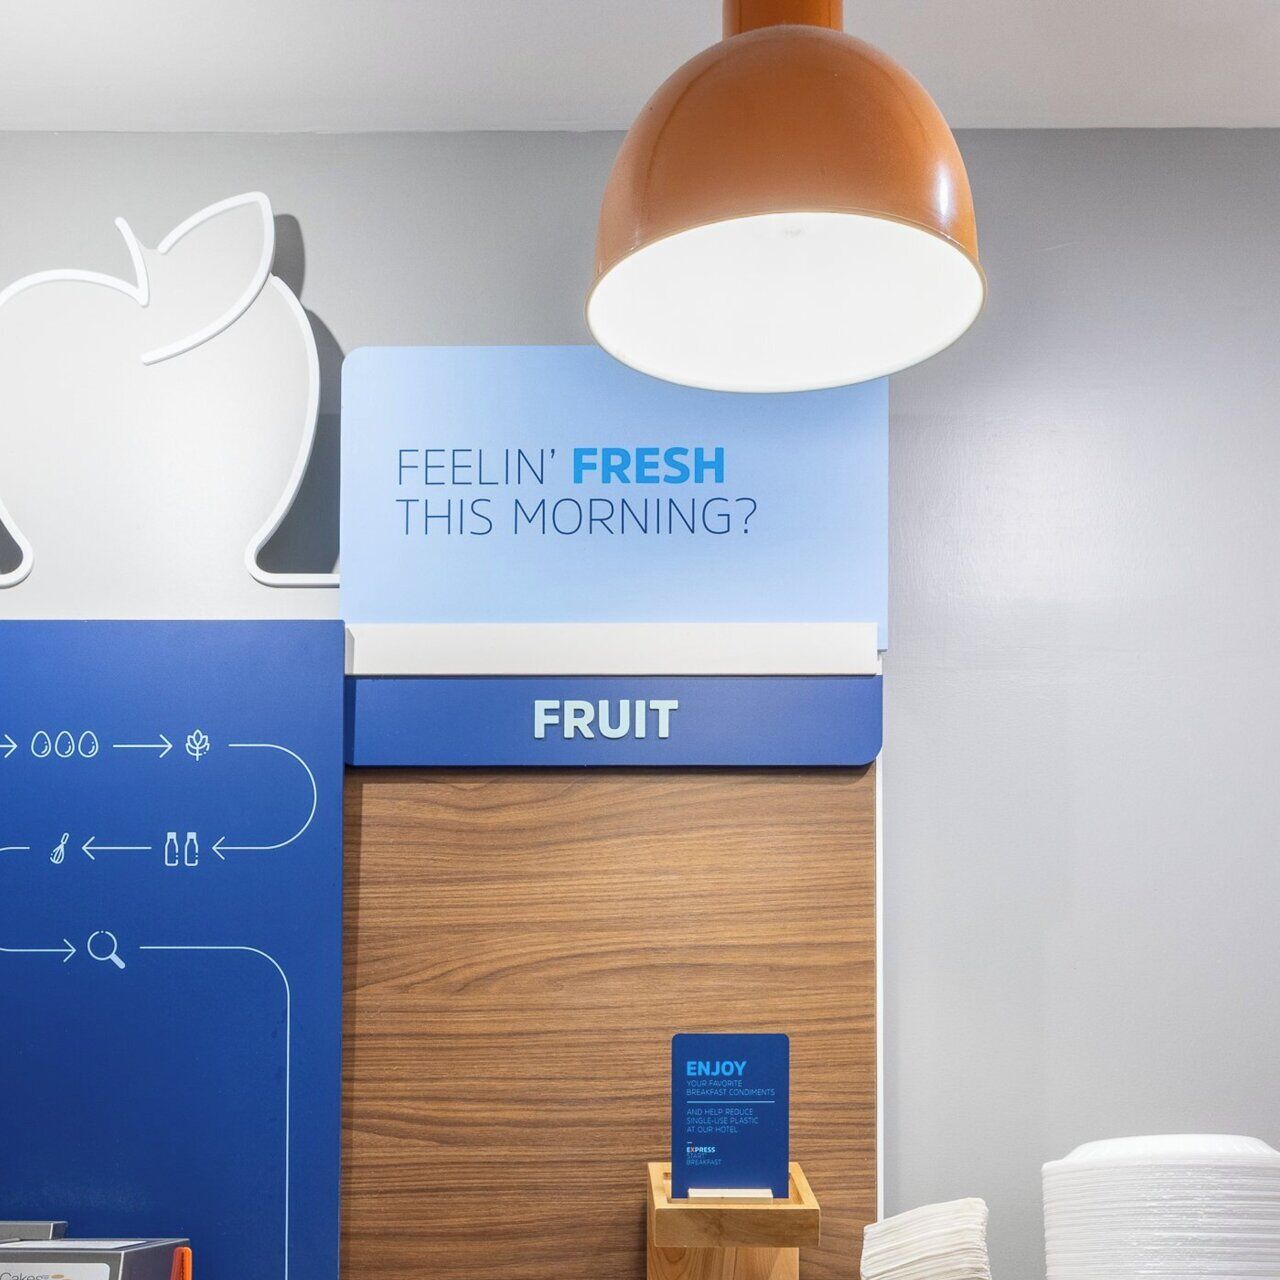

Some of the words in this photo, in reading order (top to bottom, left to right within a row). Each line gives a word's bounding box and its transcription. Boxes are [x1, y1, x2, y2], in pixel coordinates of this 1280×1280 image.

[574, 447, 724, 484] FRESH
[396, 499, 492, 535] THIS
[515, 497, 756, 535] MORNING?
[533, 700, 678, 741] FRUIT
[687, 1061, 747, 1076] ENJOY
[729, 1088, 775, 1096] CONDIMENTS
[687, 1108, 702, 1116] AND
[704, 1108, 723, 1116] HELP
[725, 1108, 753, 1116] REDUCE
[730, 1117, 759, 1125] PLASTIC
